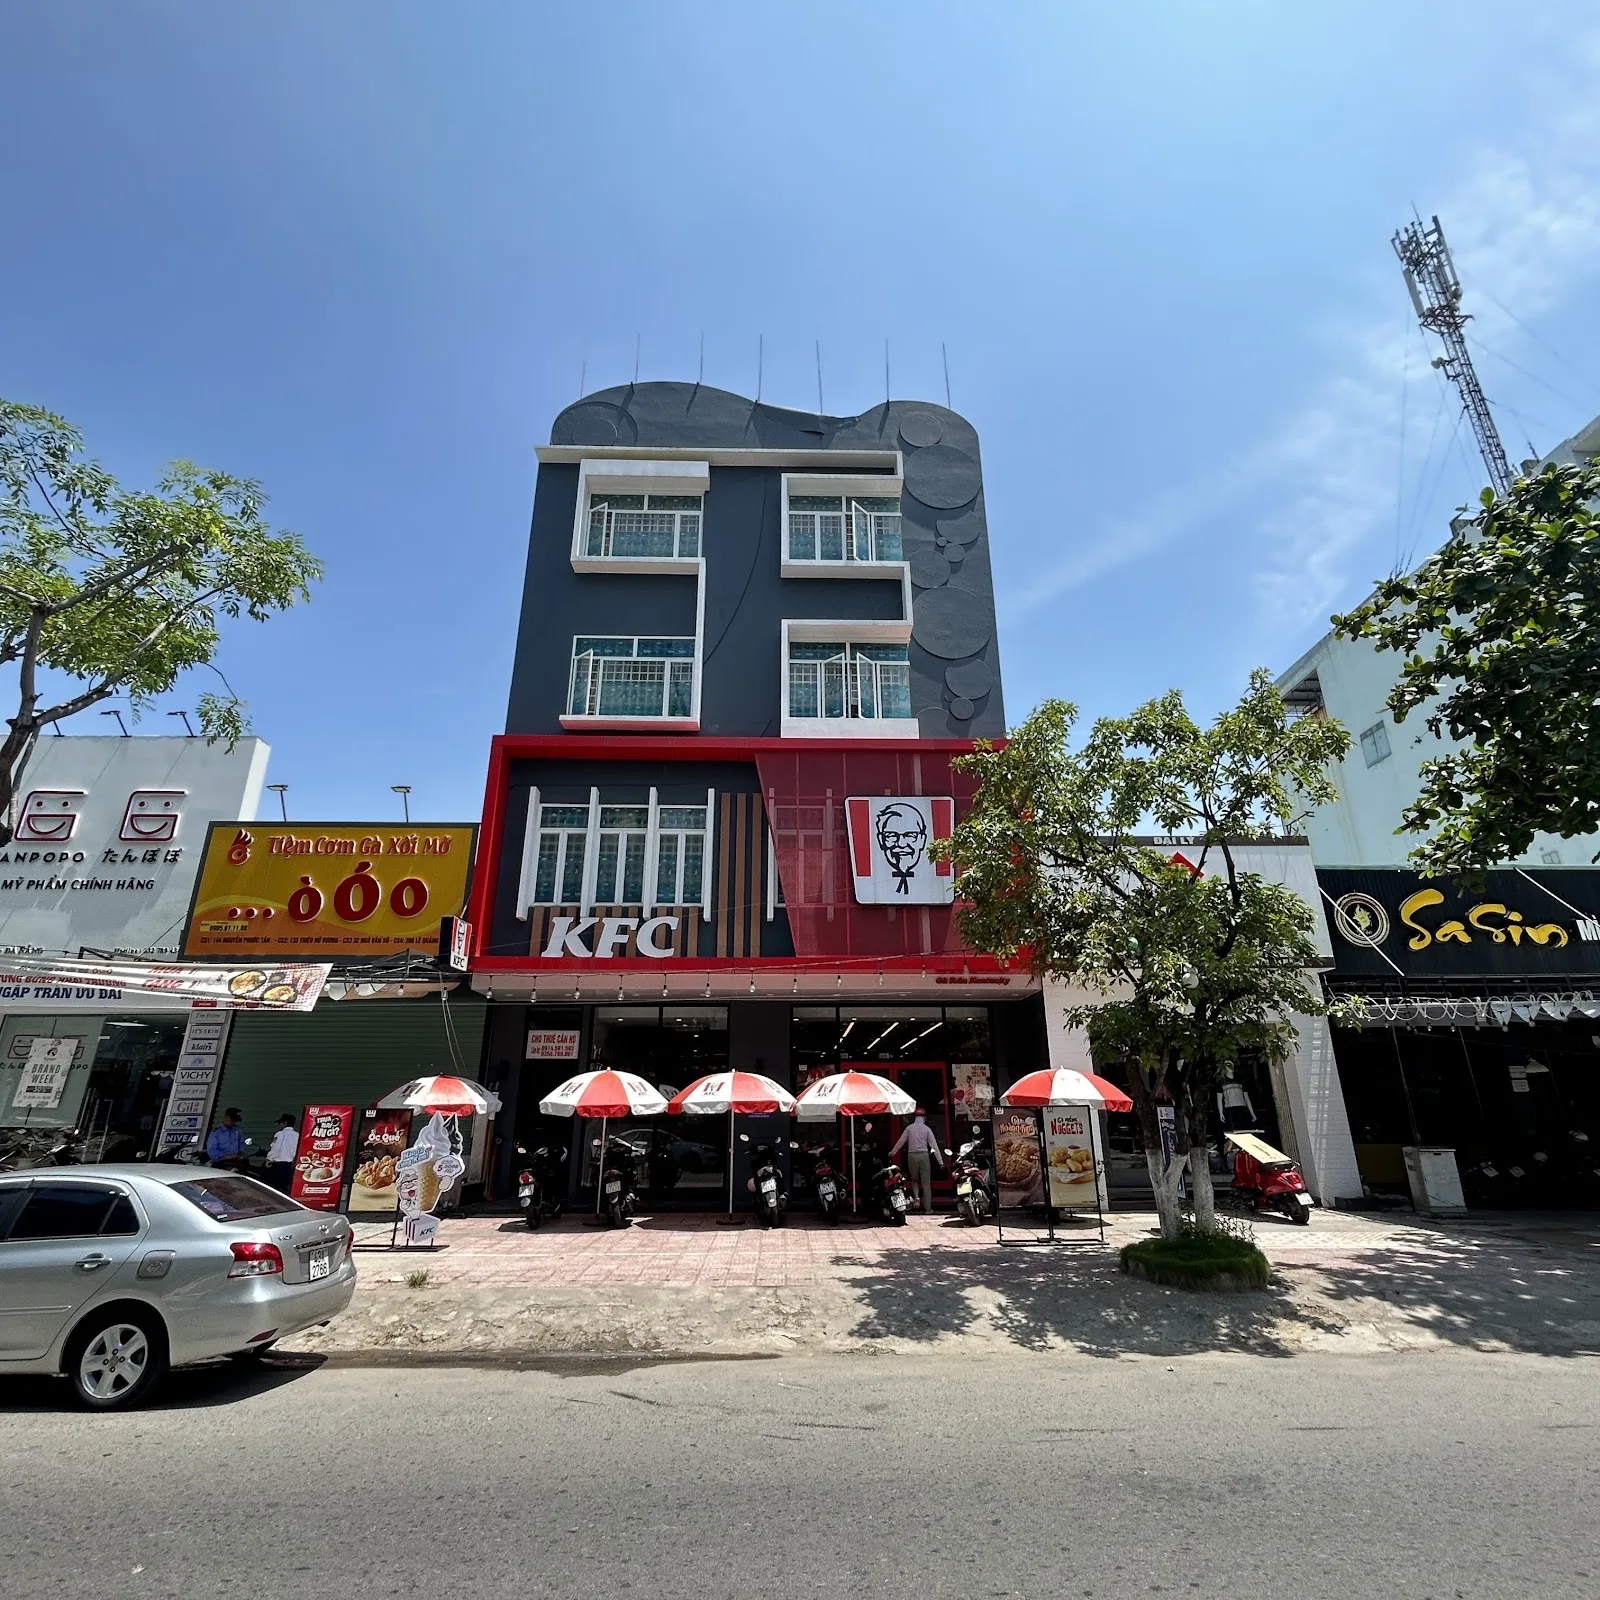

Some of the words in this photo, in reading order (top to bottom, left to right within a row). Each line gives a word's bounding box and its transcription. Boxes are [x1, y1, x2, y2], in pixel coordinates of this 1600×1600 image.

[268, 835, 311, 859] Tiệm
[314, 836, 356, 856] Cơm
[361, 836, 383, 856] Gà
[387, 833, 419, 856] Xối
[423, 835, 453, 856] Mỡ
[1153, 836, 1177, 846] ĐẠI
[101, 847, 183, 864] たんぽぽ
[1, 876, 24, 890] MỸ
[26, 874, 67, 890] PHẨM
[71, 876, 112, 890] CHÍNH
[115, 876, 155, 891] HÃNG
[541, 916, 680, 958] KFC
[453, 955, 465, 968] KFC
[531, 1034, 542, 1044] CHO
[31, 1063, 61, 1074] BRAND
[31, 1074, 56, 1084] WEEK
[180, 1071, 212, 1079] VICHY
[1050, 1118, 1084, 1136] NUGGETS
[419, 1226, 436, 1237] KFC
